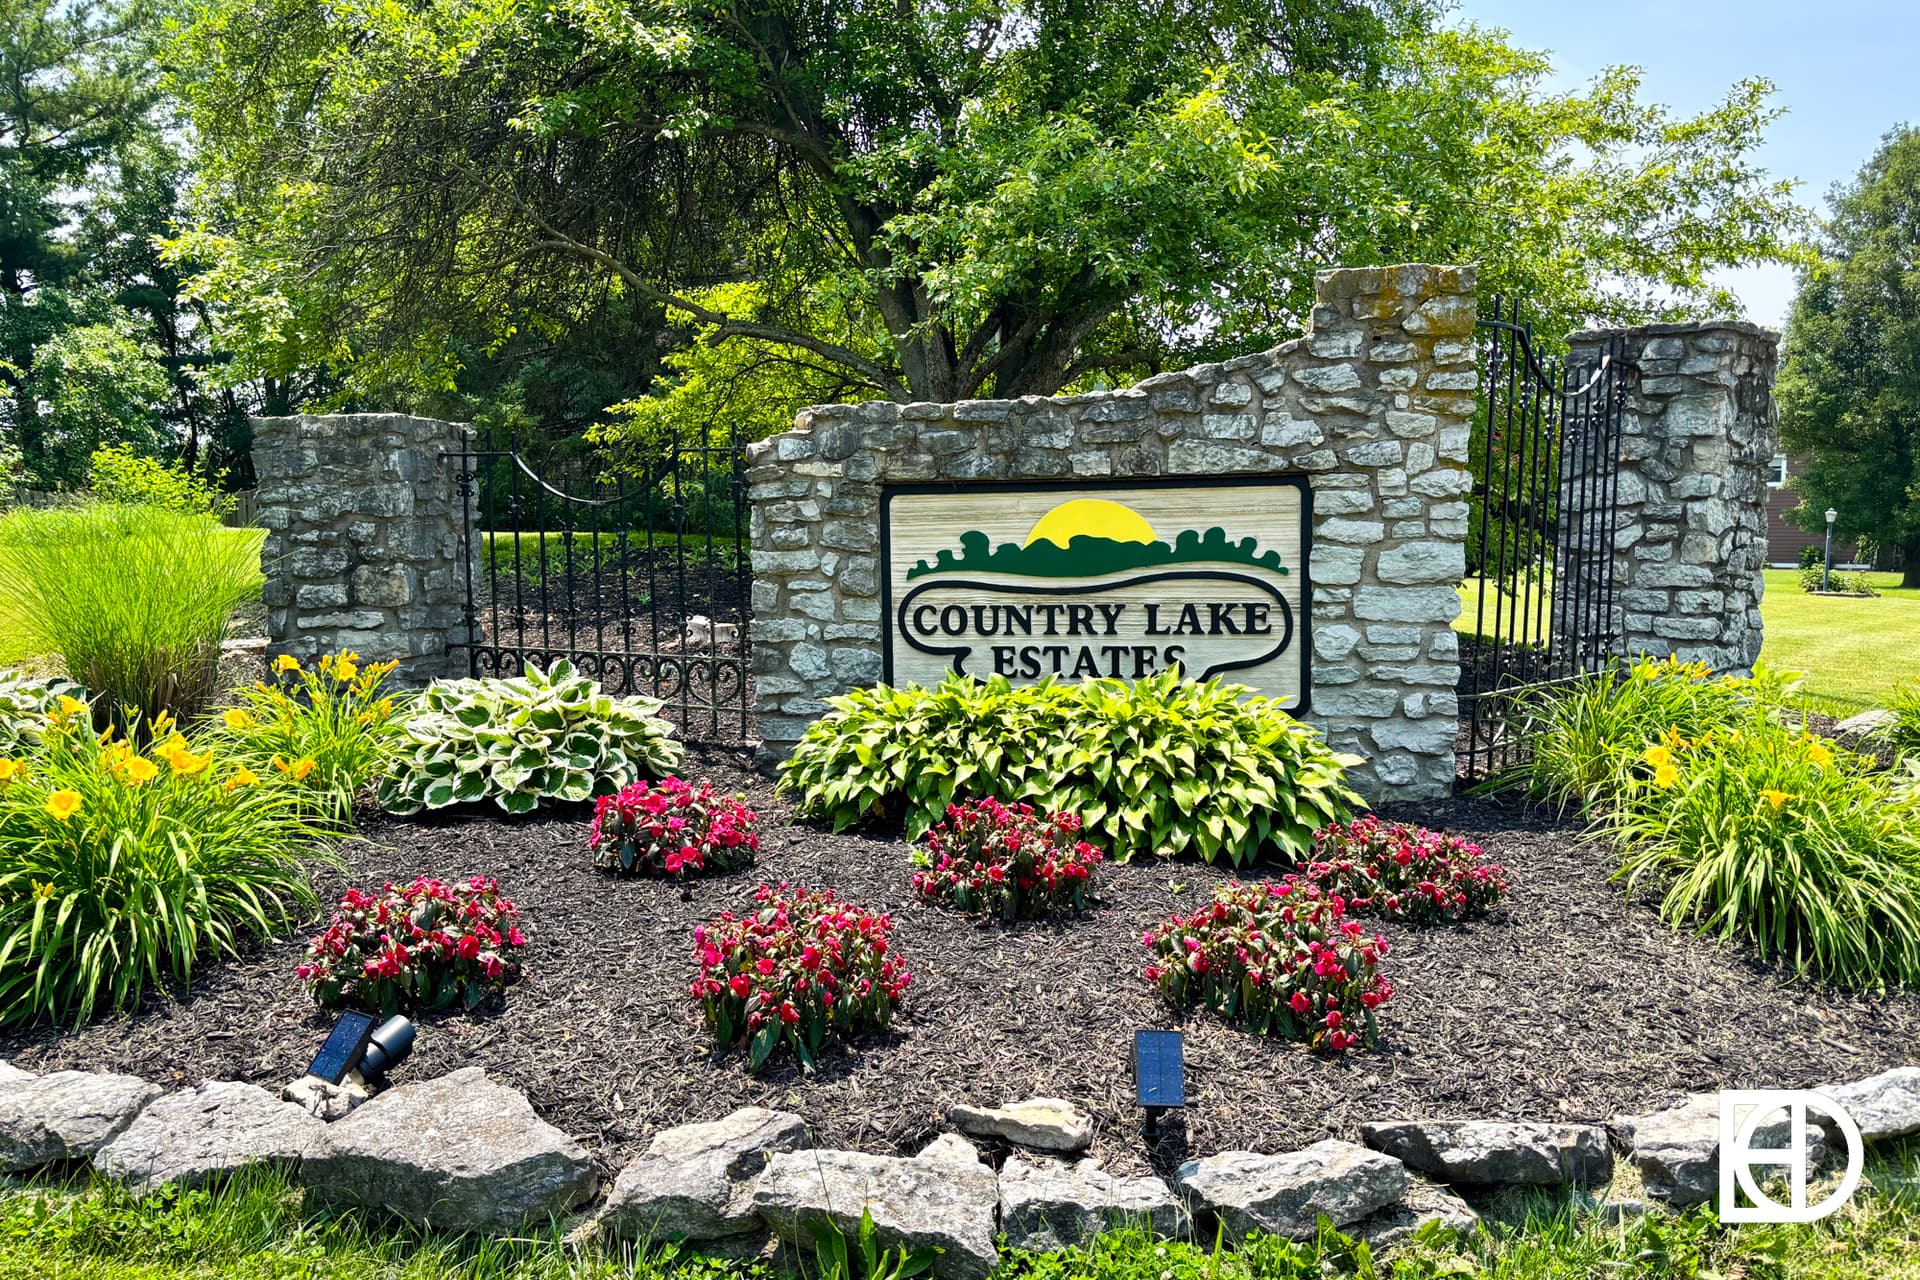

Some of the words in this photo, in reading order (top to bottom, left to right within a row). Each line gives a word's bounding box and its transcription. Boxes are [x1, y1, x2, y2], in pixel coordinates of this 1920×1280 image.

[913, 603, 1126, 636] COUNTRY
[1144, 602, 1273, 635] LAKE
[990, 645, 1186, 679] ESTATES
